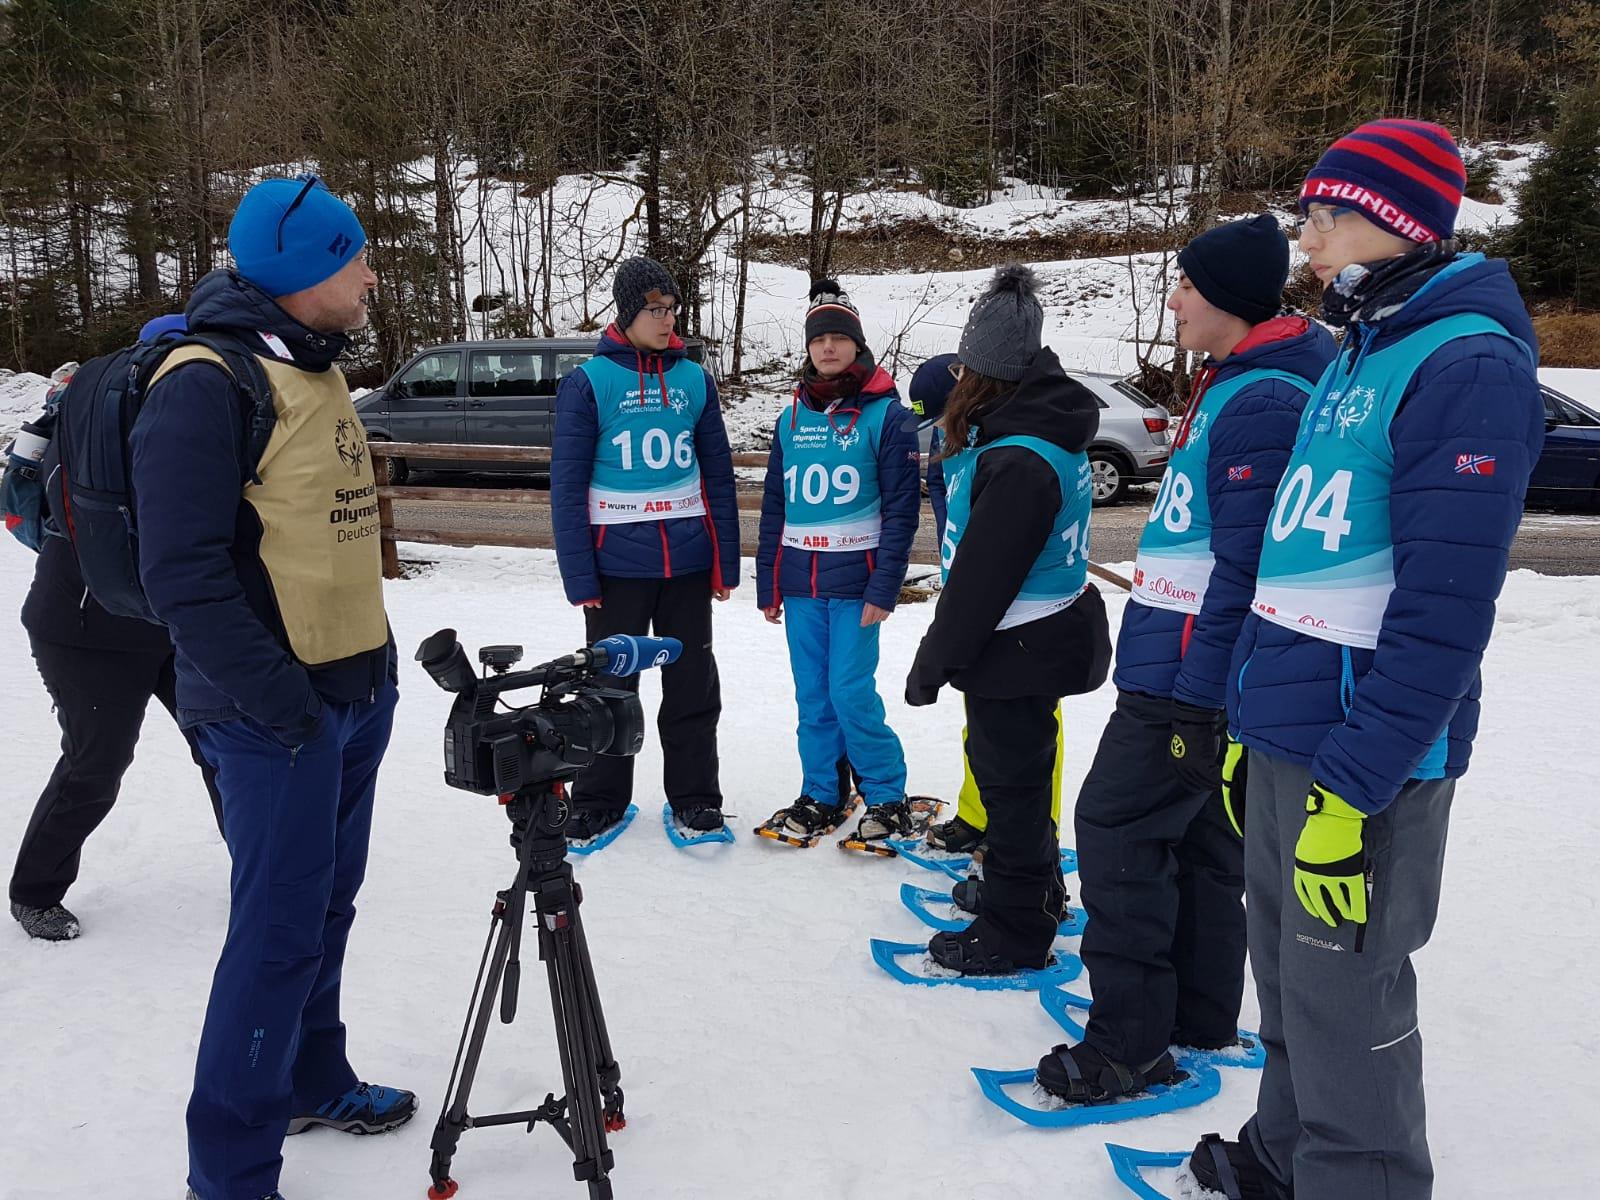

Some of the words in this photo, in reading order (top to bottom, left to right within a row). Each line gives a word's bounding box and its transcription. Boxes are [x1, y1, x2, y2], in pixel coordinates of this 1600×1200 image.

[800, 425, 829, 434] Special
[793, 434, 828, 442] Olympics
[795, 441, 827, 449] Deutschland
[612, 428, 693, 470] 106
[784, 463, 860, 505] 109
[643, 500, 673, 512] ABB
[1271, 464, 1353, 552] 04
[337, 523, 380, 543] Deutsc
[803, 535, 830, 547] ABB
[1149, 576, 1197, 603] s.Oliver
